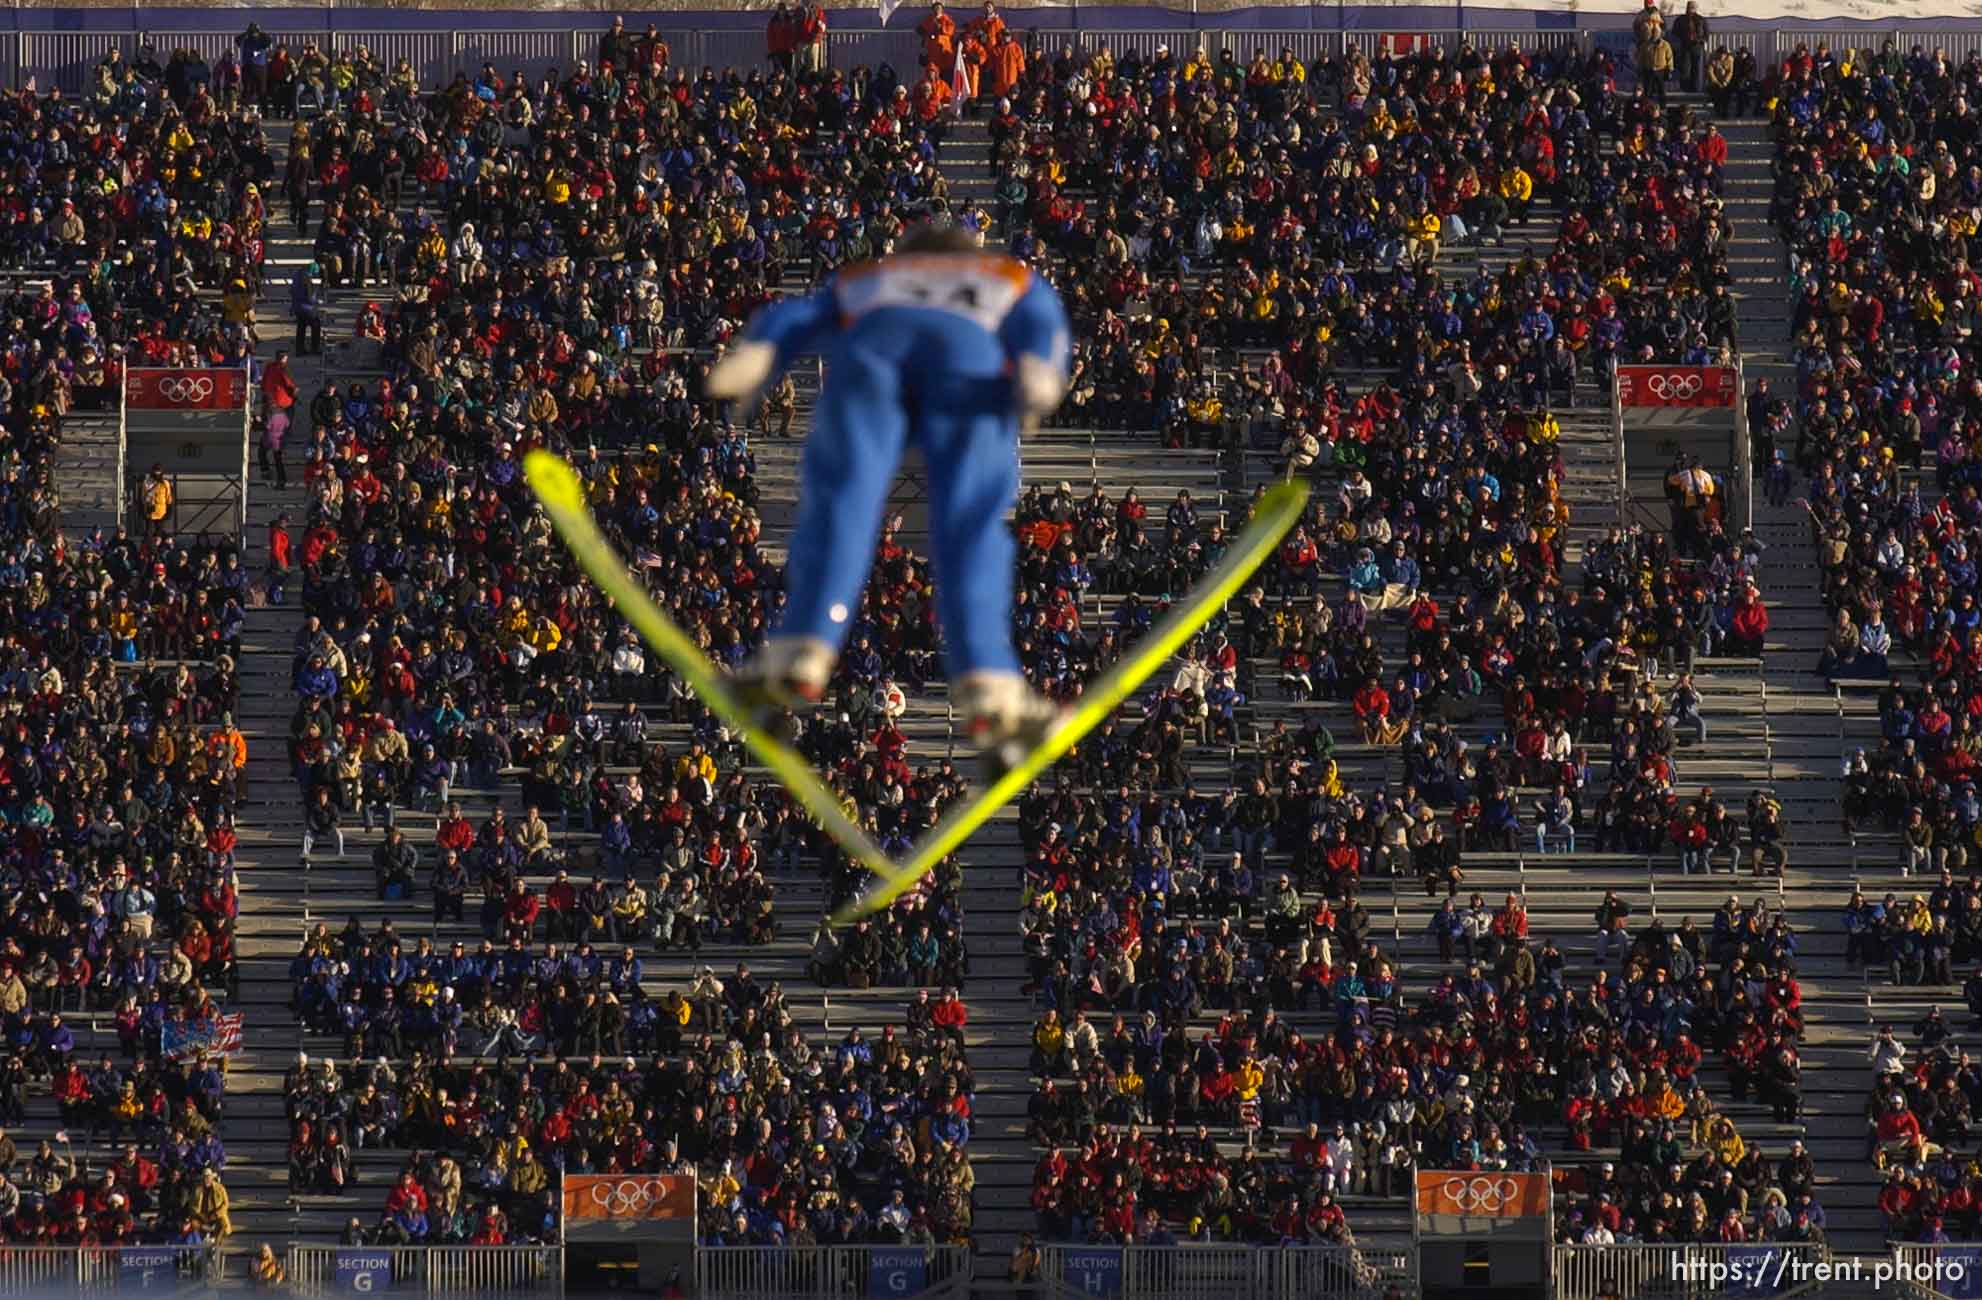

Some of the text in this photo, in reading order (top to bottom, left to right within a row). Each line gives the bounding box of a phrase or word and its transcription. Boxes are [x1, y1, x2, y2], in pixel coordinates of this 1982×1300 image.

[121, 1255, 173, 1267] SECTION
[336, 1258, 389, 1269] SECTION
[872, 1256, 923, 1267] SECTION
[1067, 1256, 1120, 1269] SECTION
[142, 1270, 154, 1288] F
[354, 1273, 372, 1292] G
[888, 1271, 907, 1290] G
[1085, 1271, 1102, 1292] H
